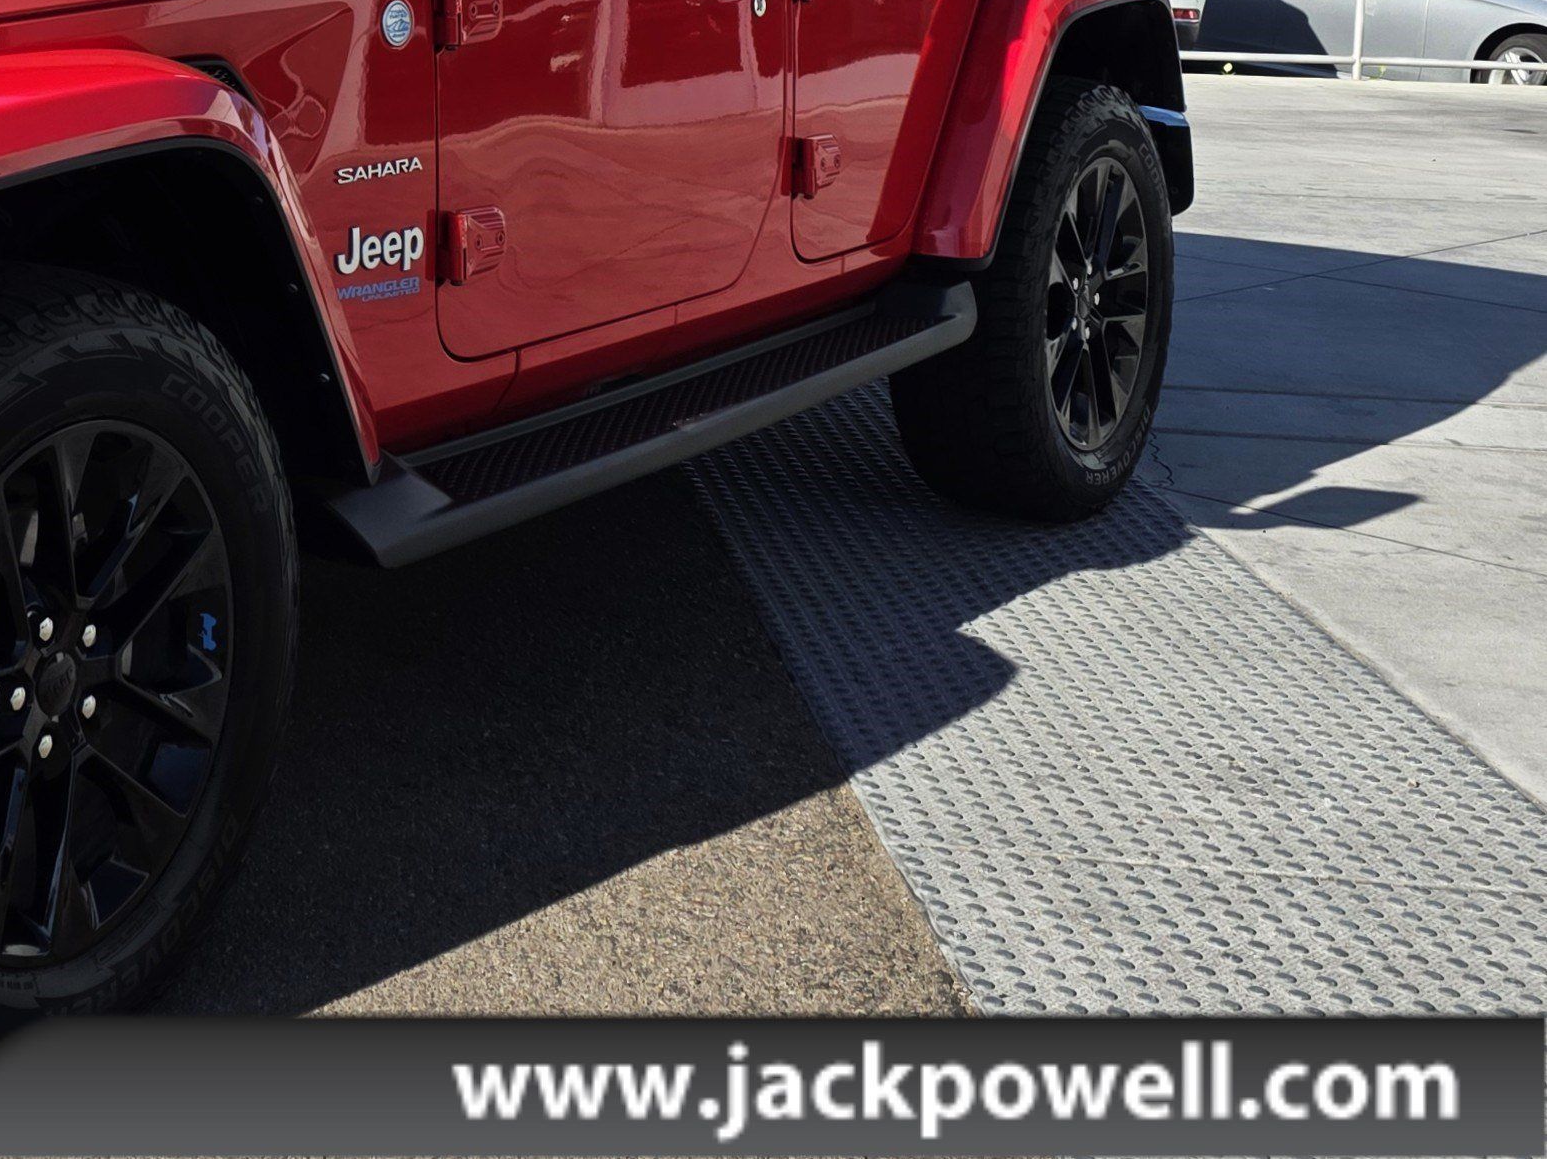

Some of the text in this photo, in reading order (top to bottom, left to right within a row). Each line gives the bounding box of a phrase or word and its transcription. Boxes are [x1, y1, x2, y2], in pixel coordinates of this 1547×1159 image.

[336, 156, 423, 185] SAHARA
[336, 225, 424, 275] Jeep
[336, 276, 420, 300] WRANGLER
[160, 372, 274, 516] COOPER
[1085, 402, 1151, 485] DISCOVERER
